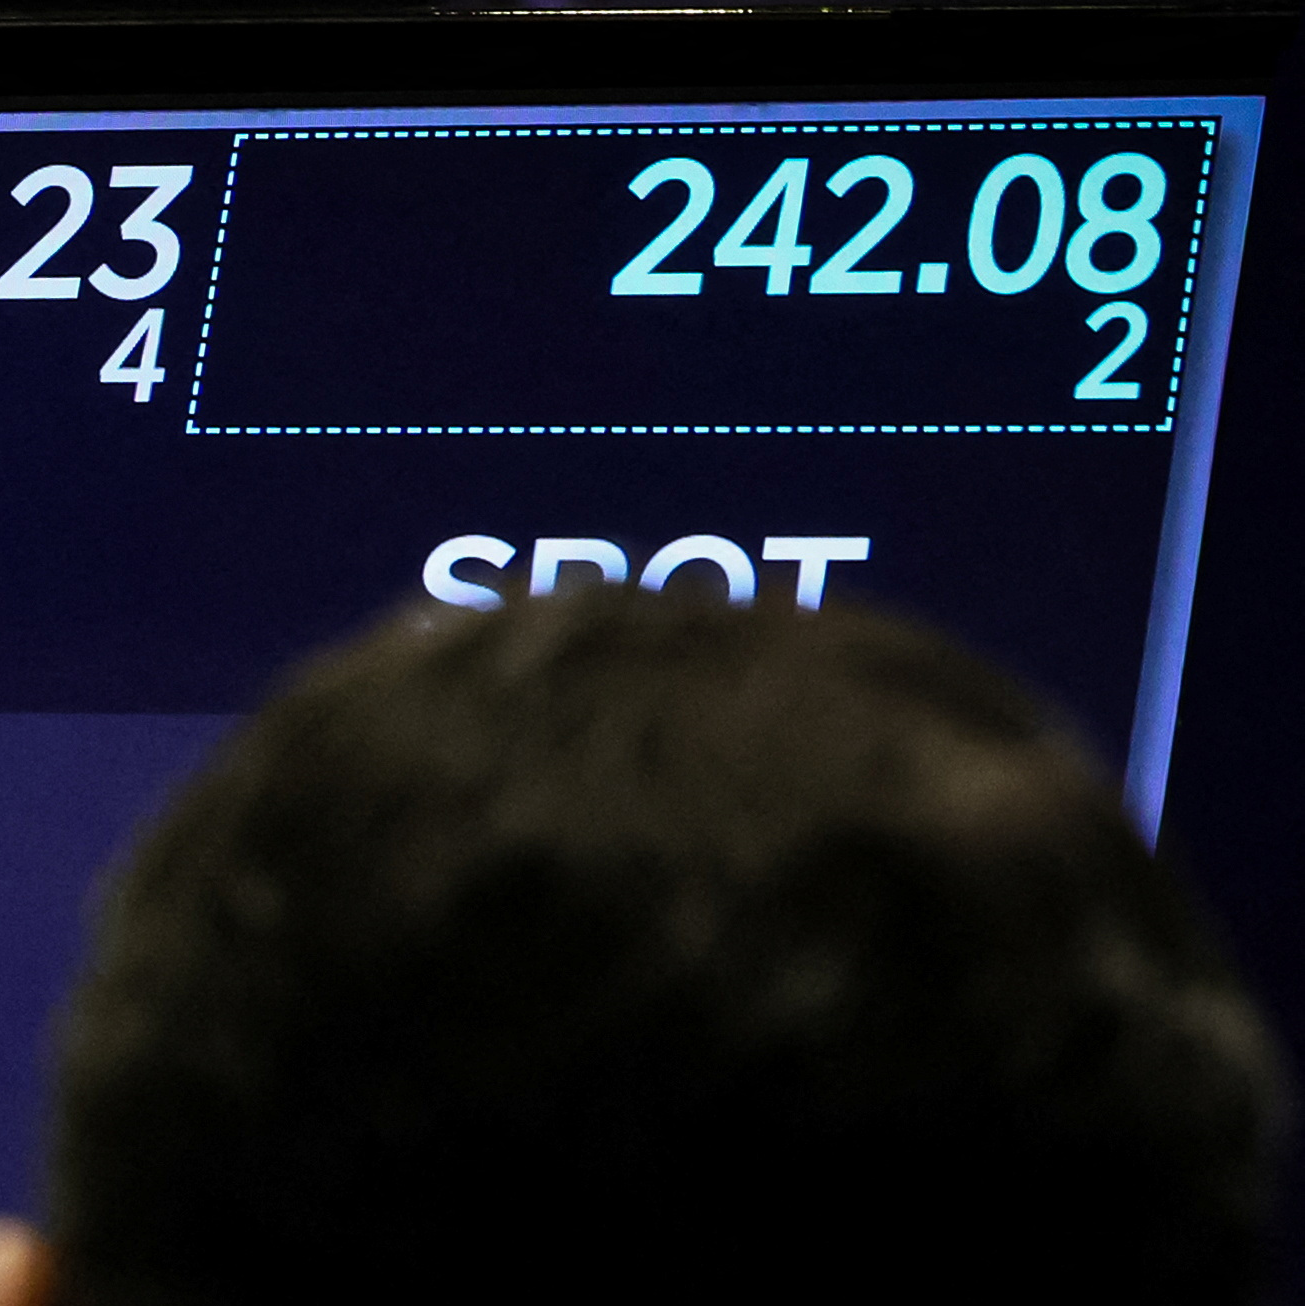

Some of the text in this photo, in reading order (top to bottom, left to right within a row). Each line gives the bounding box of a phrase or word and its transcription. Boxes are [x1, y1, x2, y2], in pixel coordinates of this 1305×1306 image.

[610, 152, 1167, 295] 242.08
[100, 308, 166, 403] 4
[1074, 301, 1149, 400] 2
